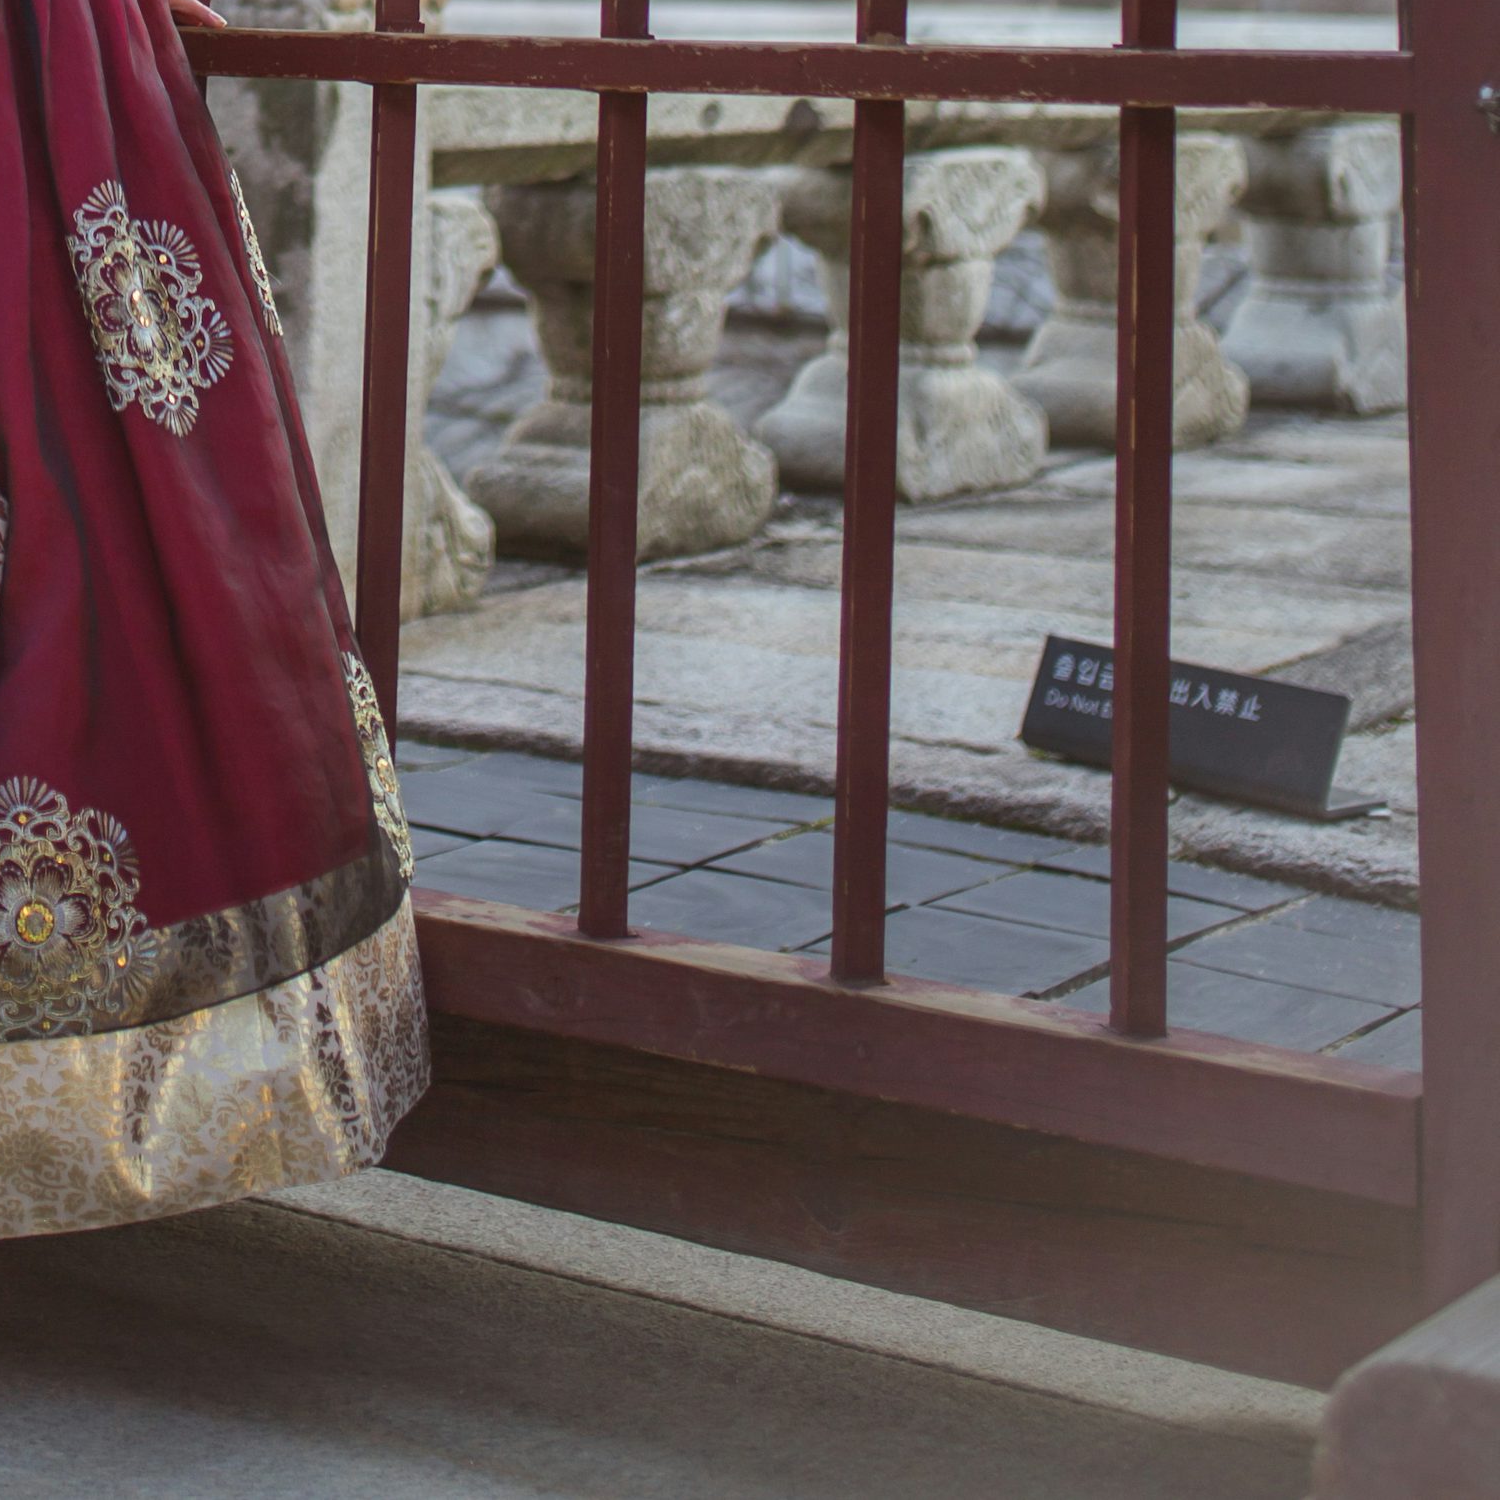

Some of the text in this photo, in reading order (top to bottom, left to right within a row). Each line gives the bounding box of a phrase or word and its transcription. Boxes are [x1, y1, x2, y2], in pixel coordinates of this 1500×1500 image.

[1052, 653, 1114, 691] 출입금
[1044, 688, 1069, 709] Do
[1070, 693, 1099, 716] Not
